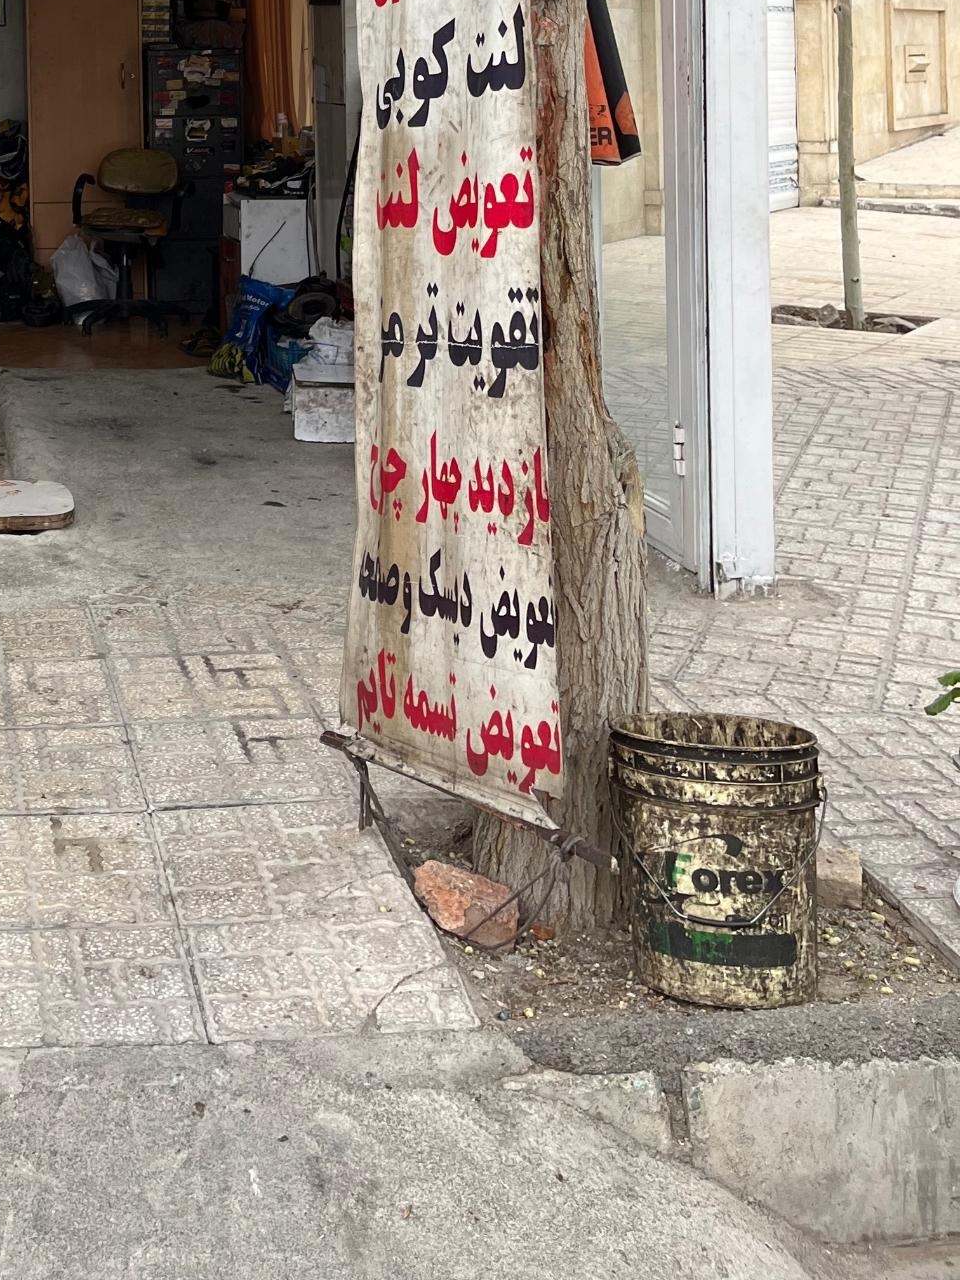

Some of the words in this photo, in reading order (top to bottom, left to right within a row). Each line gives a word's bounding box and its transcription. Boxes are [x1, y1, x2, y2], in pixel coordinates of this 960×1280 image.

[375, 17, 457, 131] کوبی
[465, 2, 527, 99] لنت
[431, 146, 537, 259] تعویض
[377, 281, 439, 389] ترم
[447, 286, 541, 399] تقویت
[415, 429, 463, 535] چهار
[400, 570, 413, 635] و
[418, 547, 473, 648] دیسک
[356, 647, 397, 735] تایم
[402, 671, 458, 743] تسمه
[465, 683, 561, 795] تعویض
